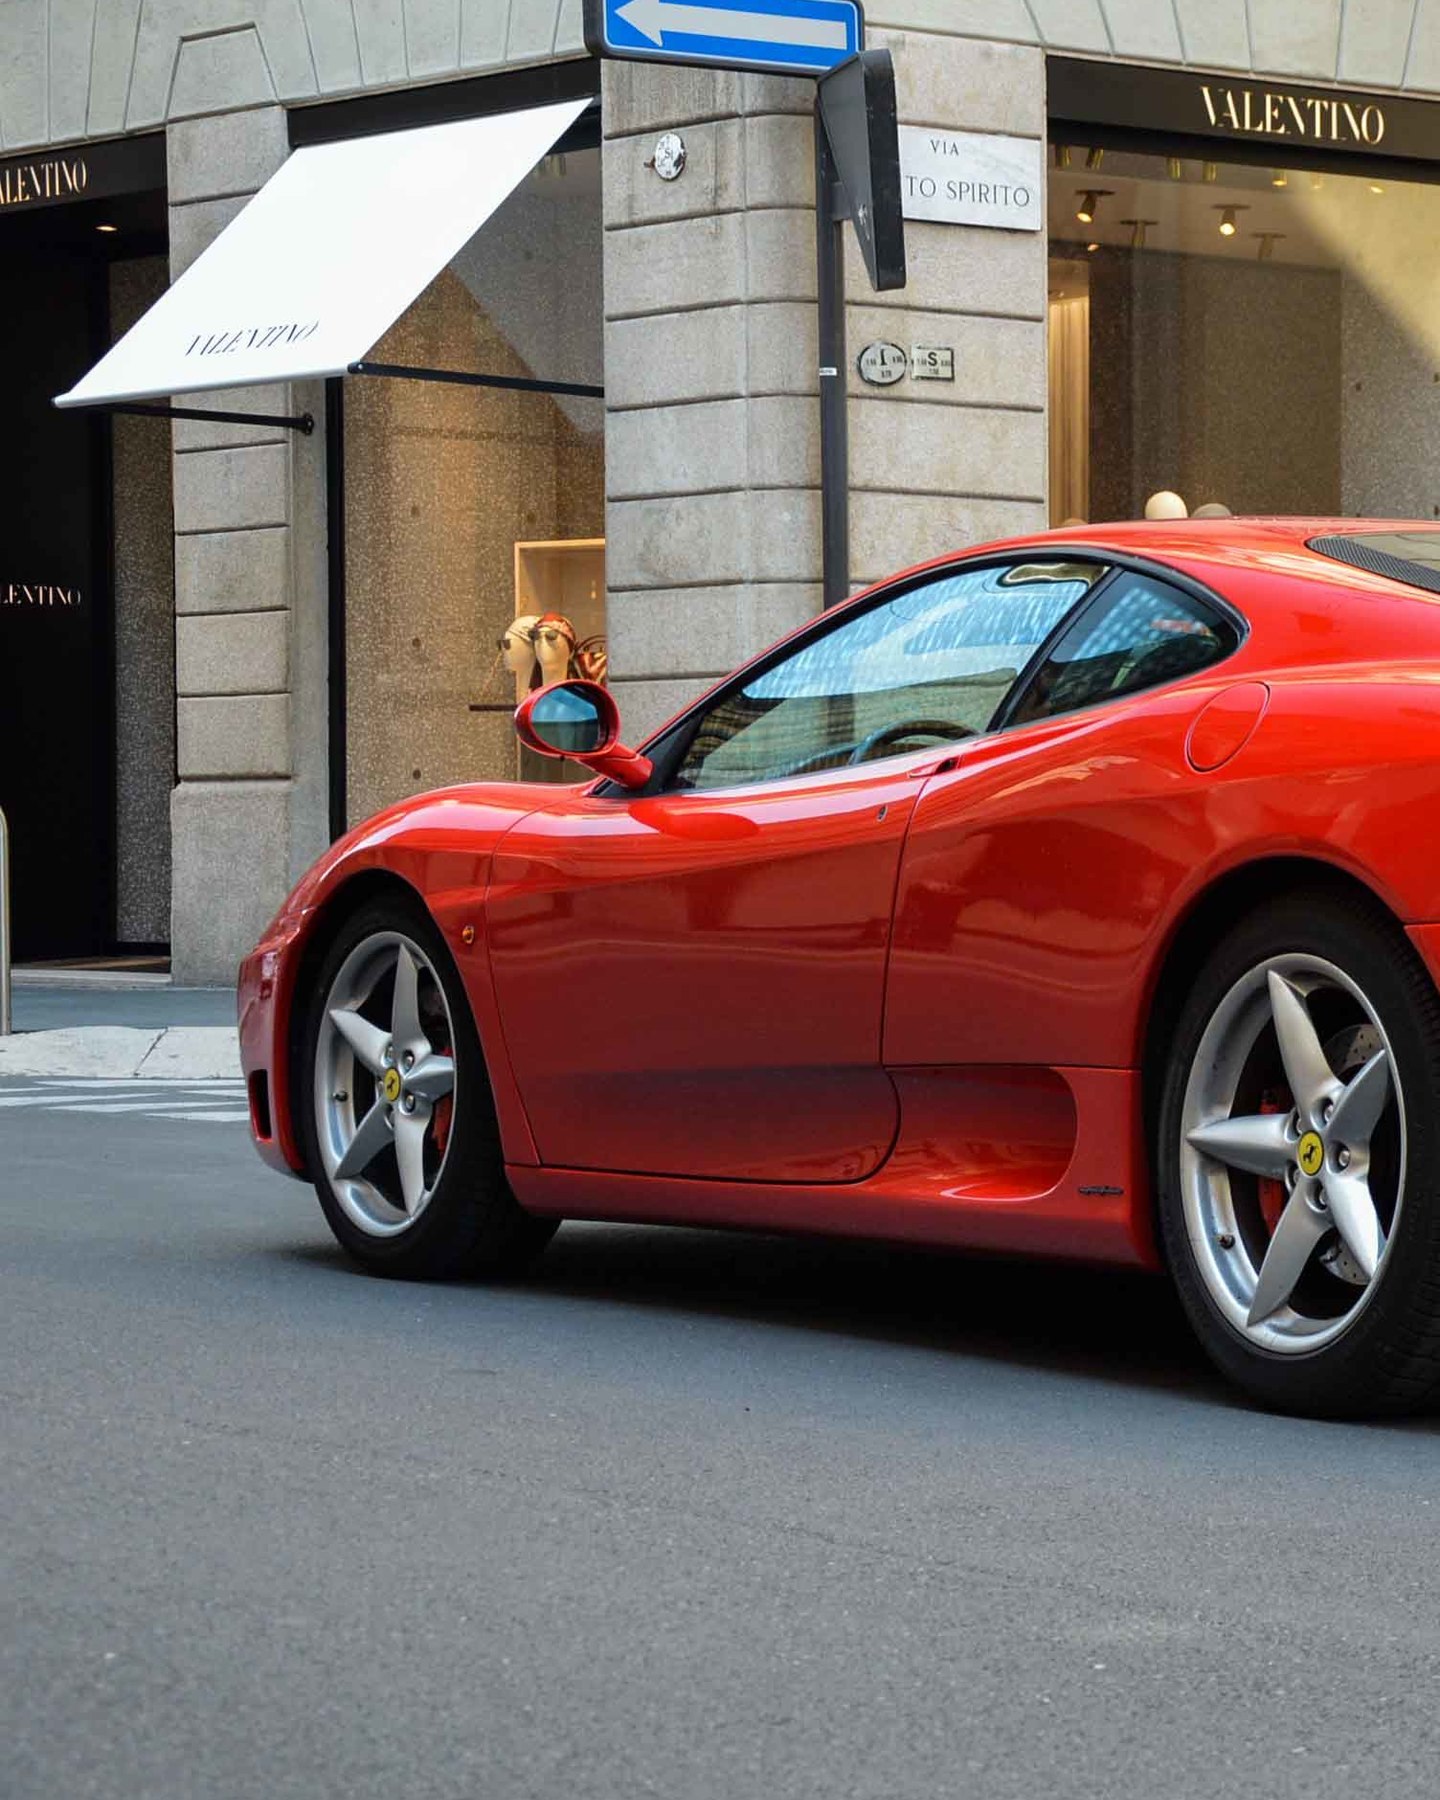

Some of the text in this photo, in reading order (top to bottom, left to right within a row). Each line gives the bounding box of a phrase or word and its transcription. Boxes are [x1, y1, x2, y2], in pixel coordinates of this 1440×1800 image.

[1201, 86, 1385, 145] VALENTINO
[930, 139, 959, 156] VIA
[946, 180, 1030, 207] SPIRITO
[185, 320, 319, 356] VALENTINO
[927, 351, 938, 367] S
